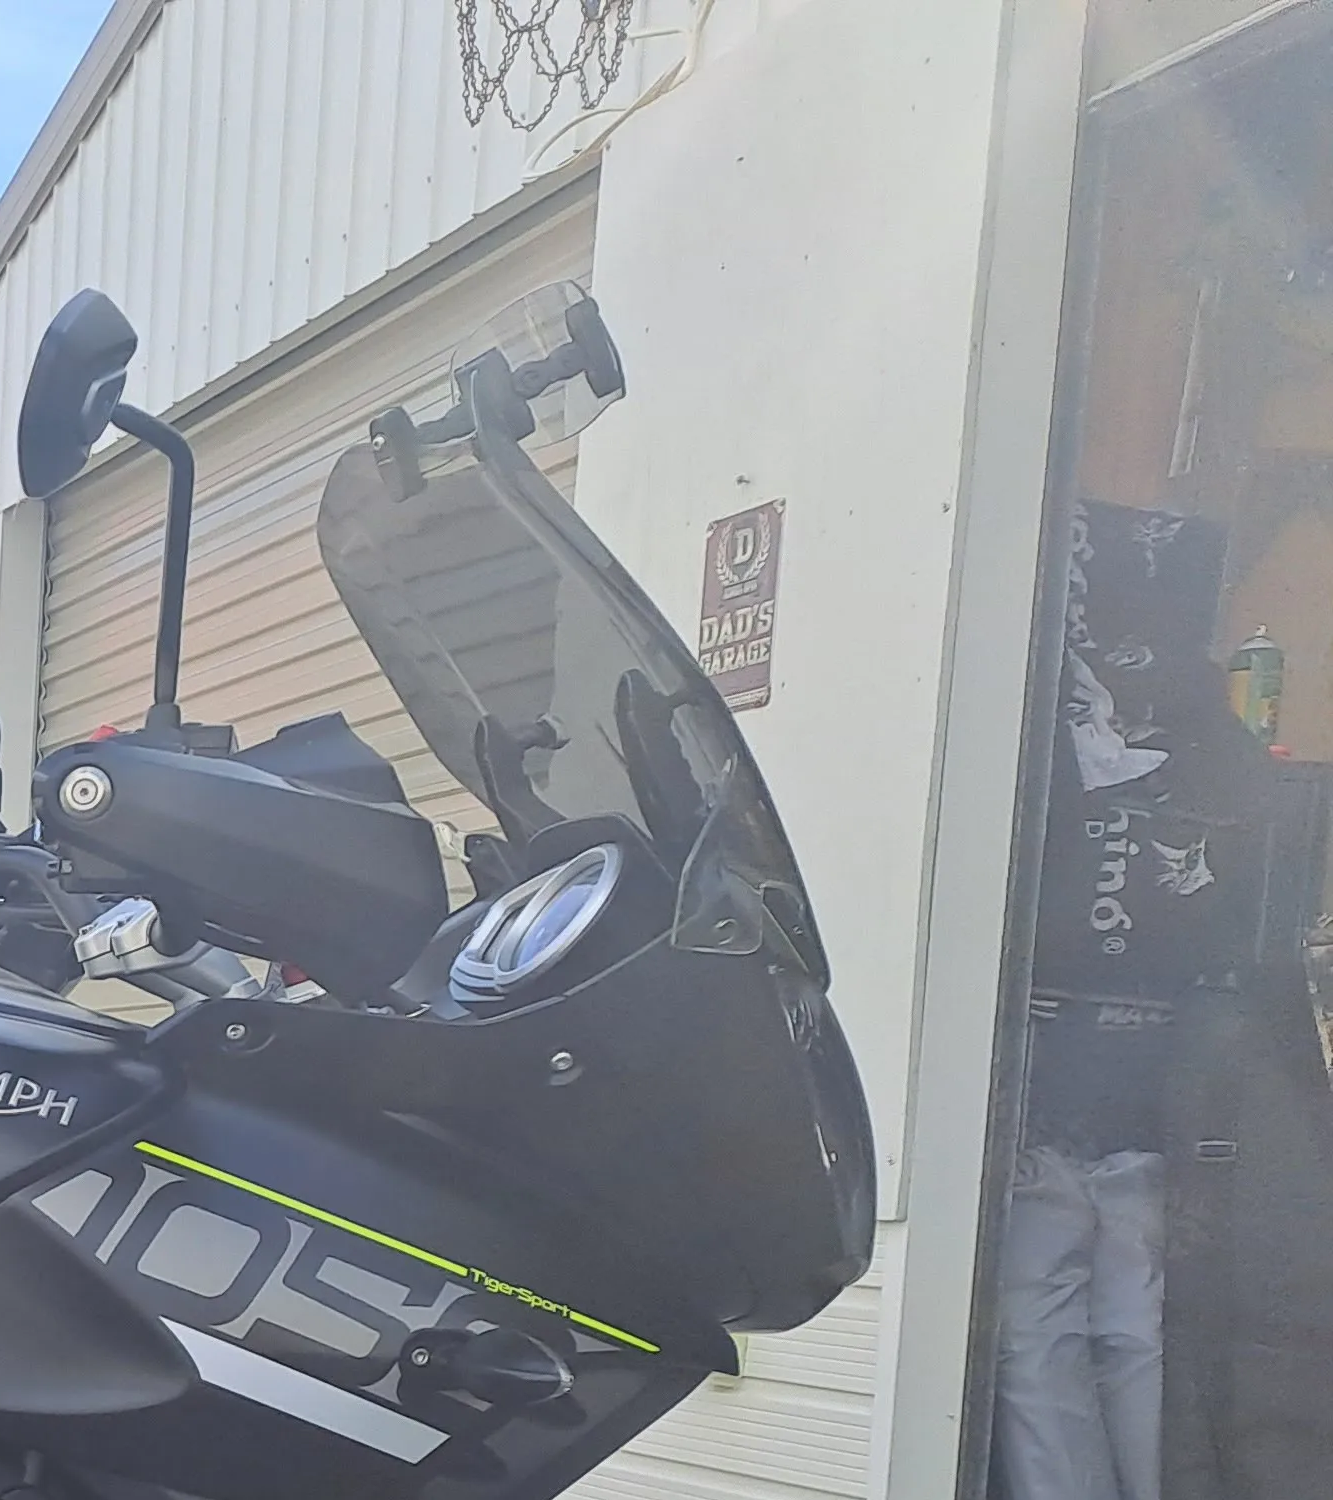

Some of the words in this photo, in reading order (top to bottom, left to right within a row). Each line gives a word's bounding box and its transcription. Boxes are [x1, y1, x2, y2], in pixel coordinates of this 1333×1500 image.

[699, 599, 775, 651] DAD'S
[697, 636, 772, 677] GARAGE
[469, 1266, 571, 1317] TigerSport
